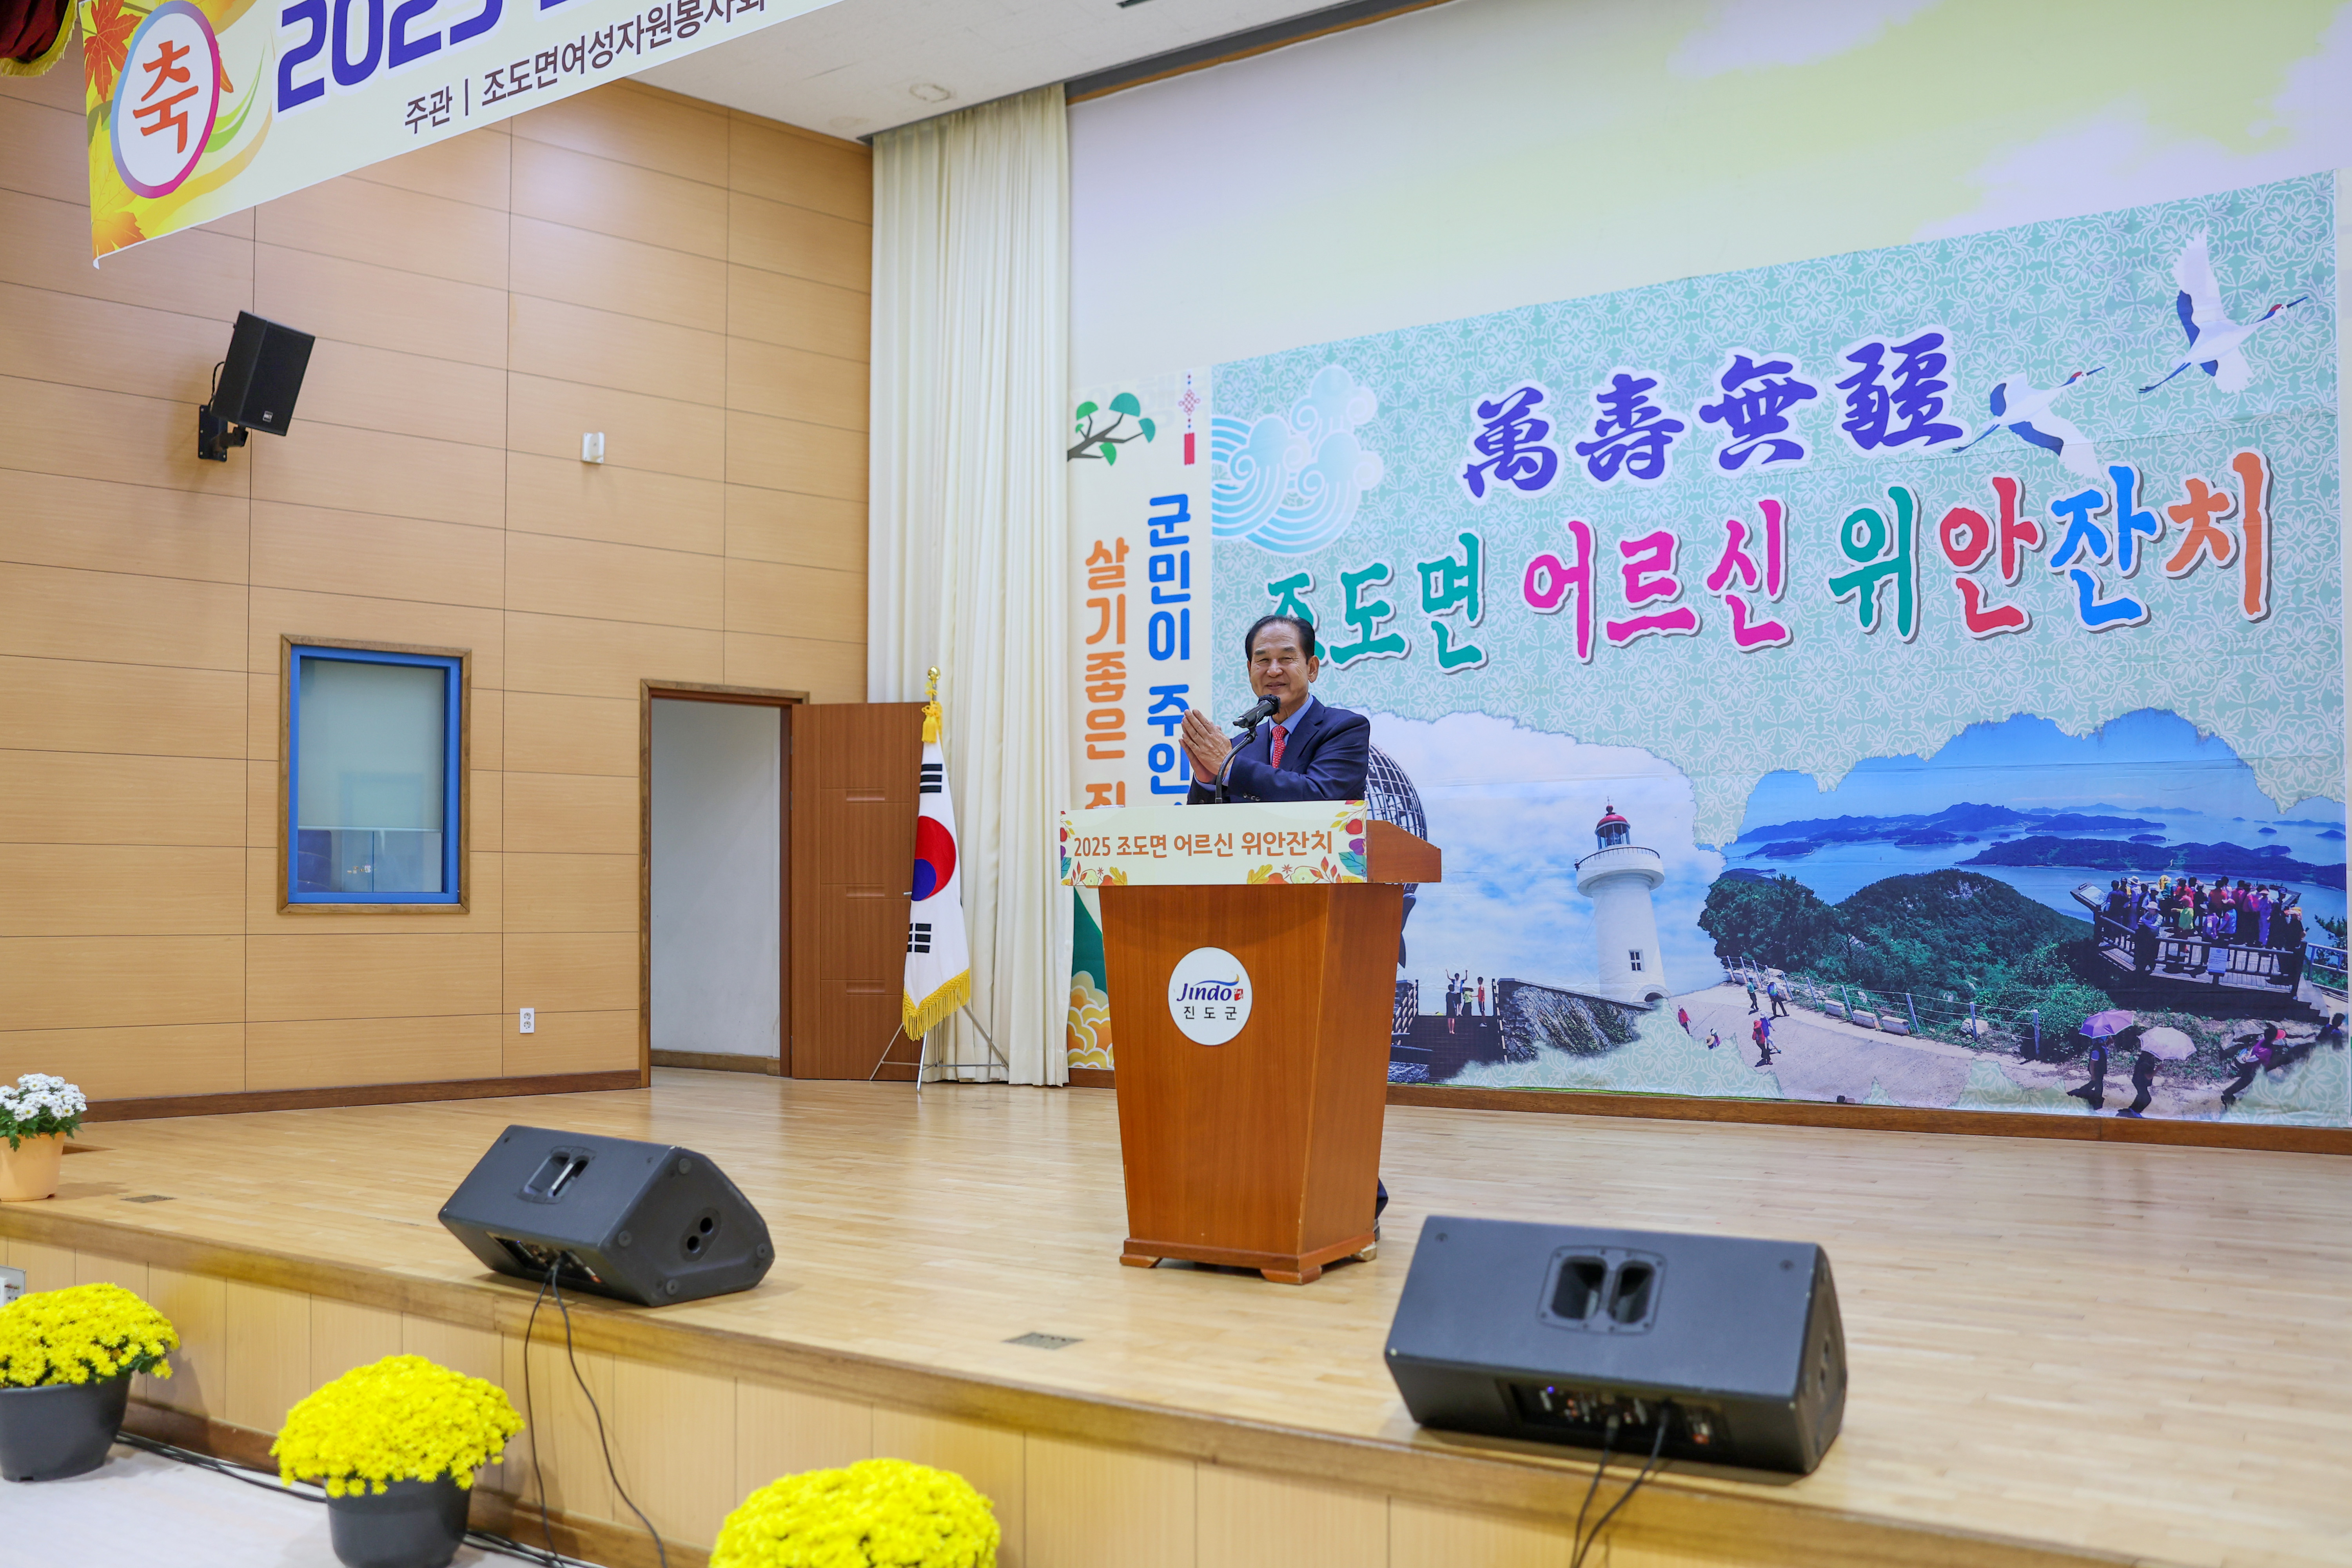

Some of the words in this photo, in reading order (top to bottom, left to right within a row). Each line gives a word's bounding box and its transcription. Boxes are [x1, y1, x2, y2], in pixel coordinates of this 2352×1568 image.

[132, 40, 198, 153] 축
[405, 86, 452, 134] 주관
[1148, 494, 1191, 661] 군민이
[1524, 500, 1786, 659] 어르신
[1829, 452, 2263, 637] 위안잔치
[1147, 684, 1190, 805] 주인
[1074, 837, 1111, 857] 2025
[1117, 835, 1167, 858] 조도면
[1174, 833, 1233, 857] 어르신
[1241, 830, 1332, 856] 위안잔치
[1176, 983, 1232, 1001] Jindo
